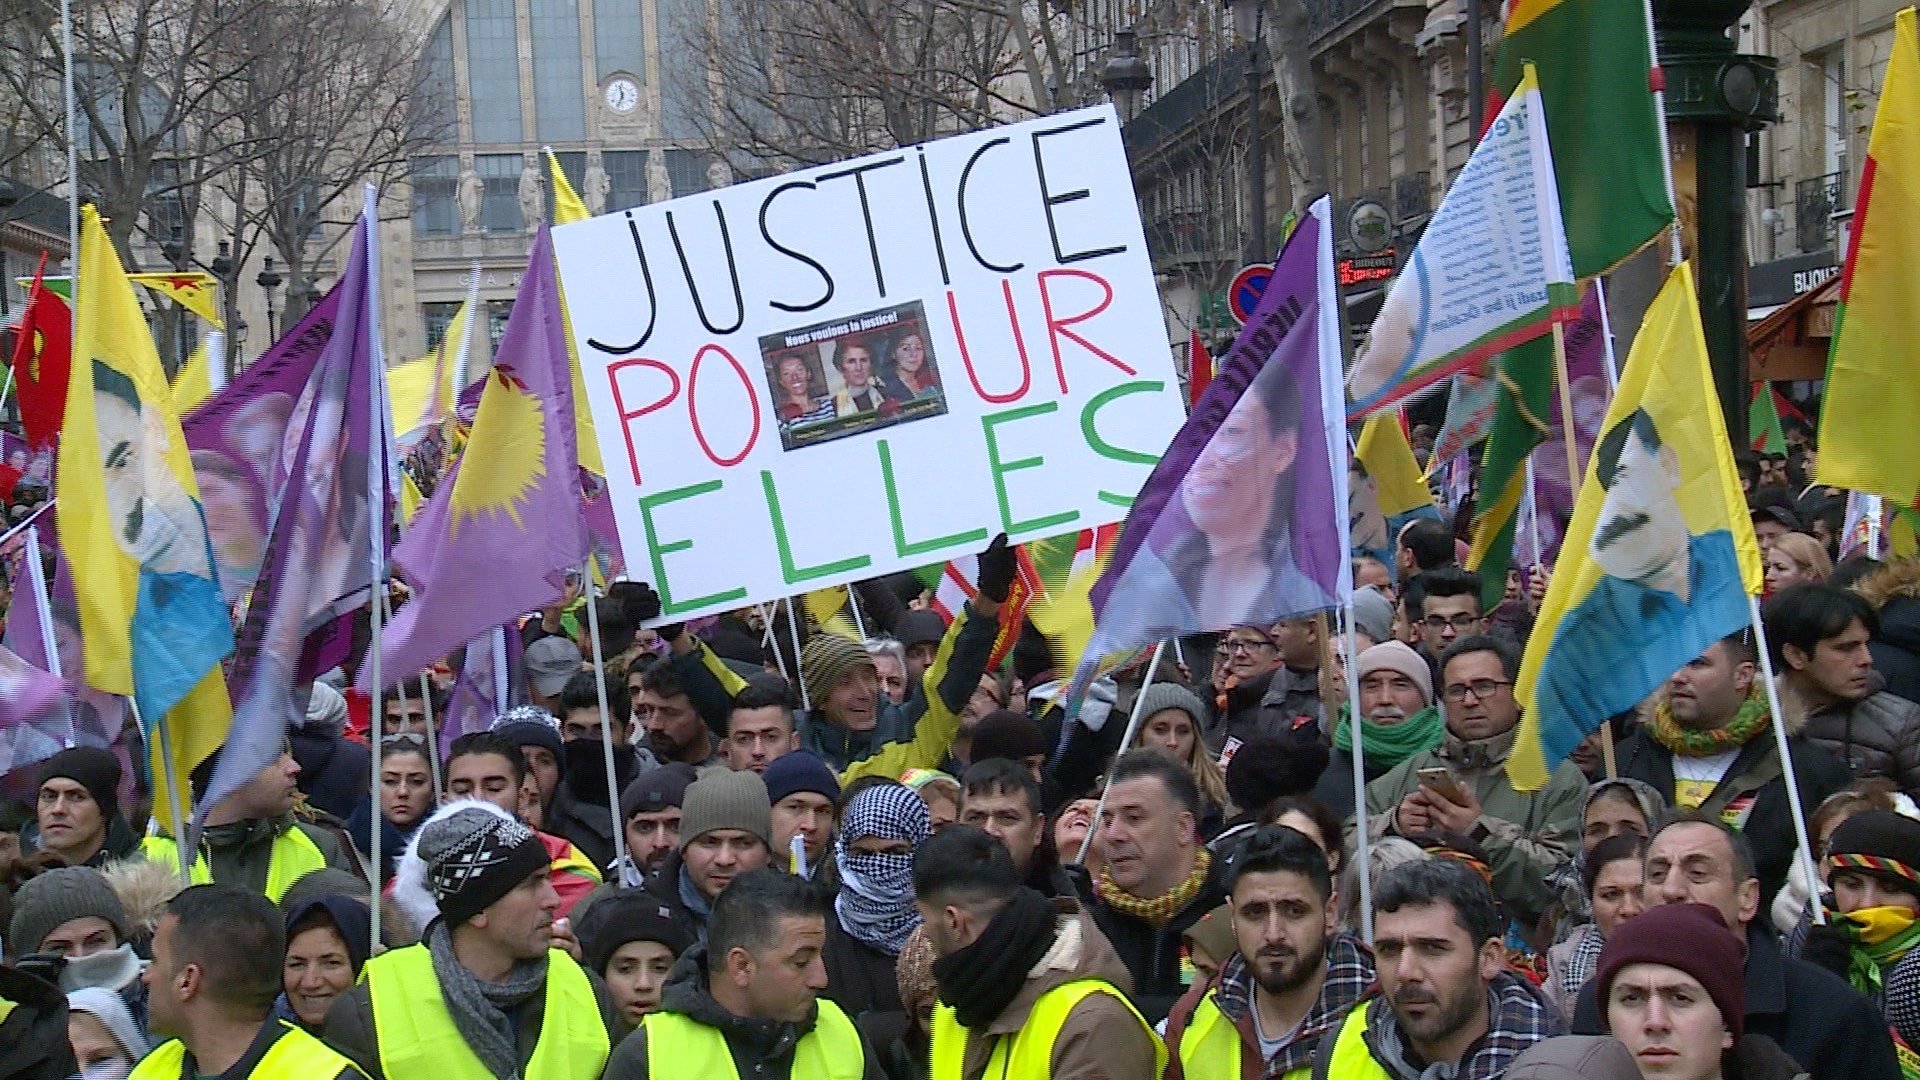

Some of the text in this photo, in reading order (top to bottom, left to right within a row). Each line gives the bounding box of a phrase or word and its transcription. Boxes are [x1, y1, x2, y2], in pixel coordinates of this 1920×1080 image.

[785, 311, 898, 348] Nous voulons la justice!
[638, 380, 1165, 616] ELLES
